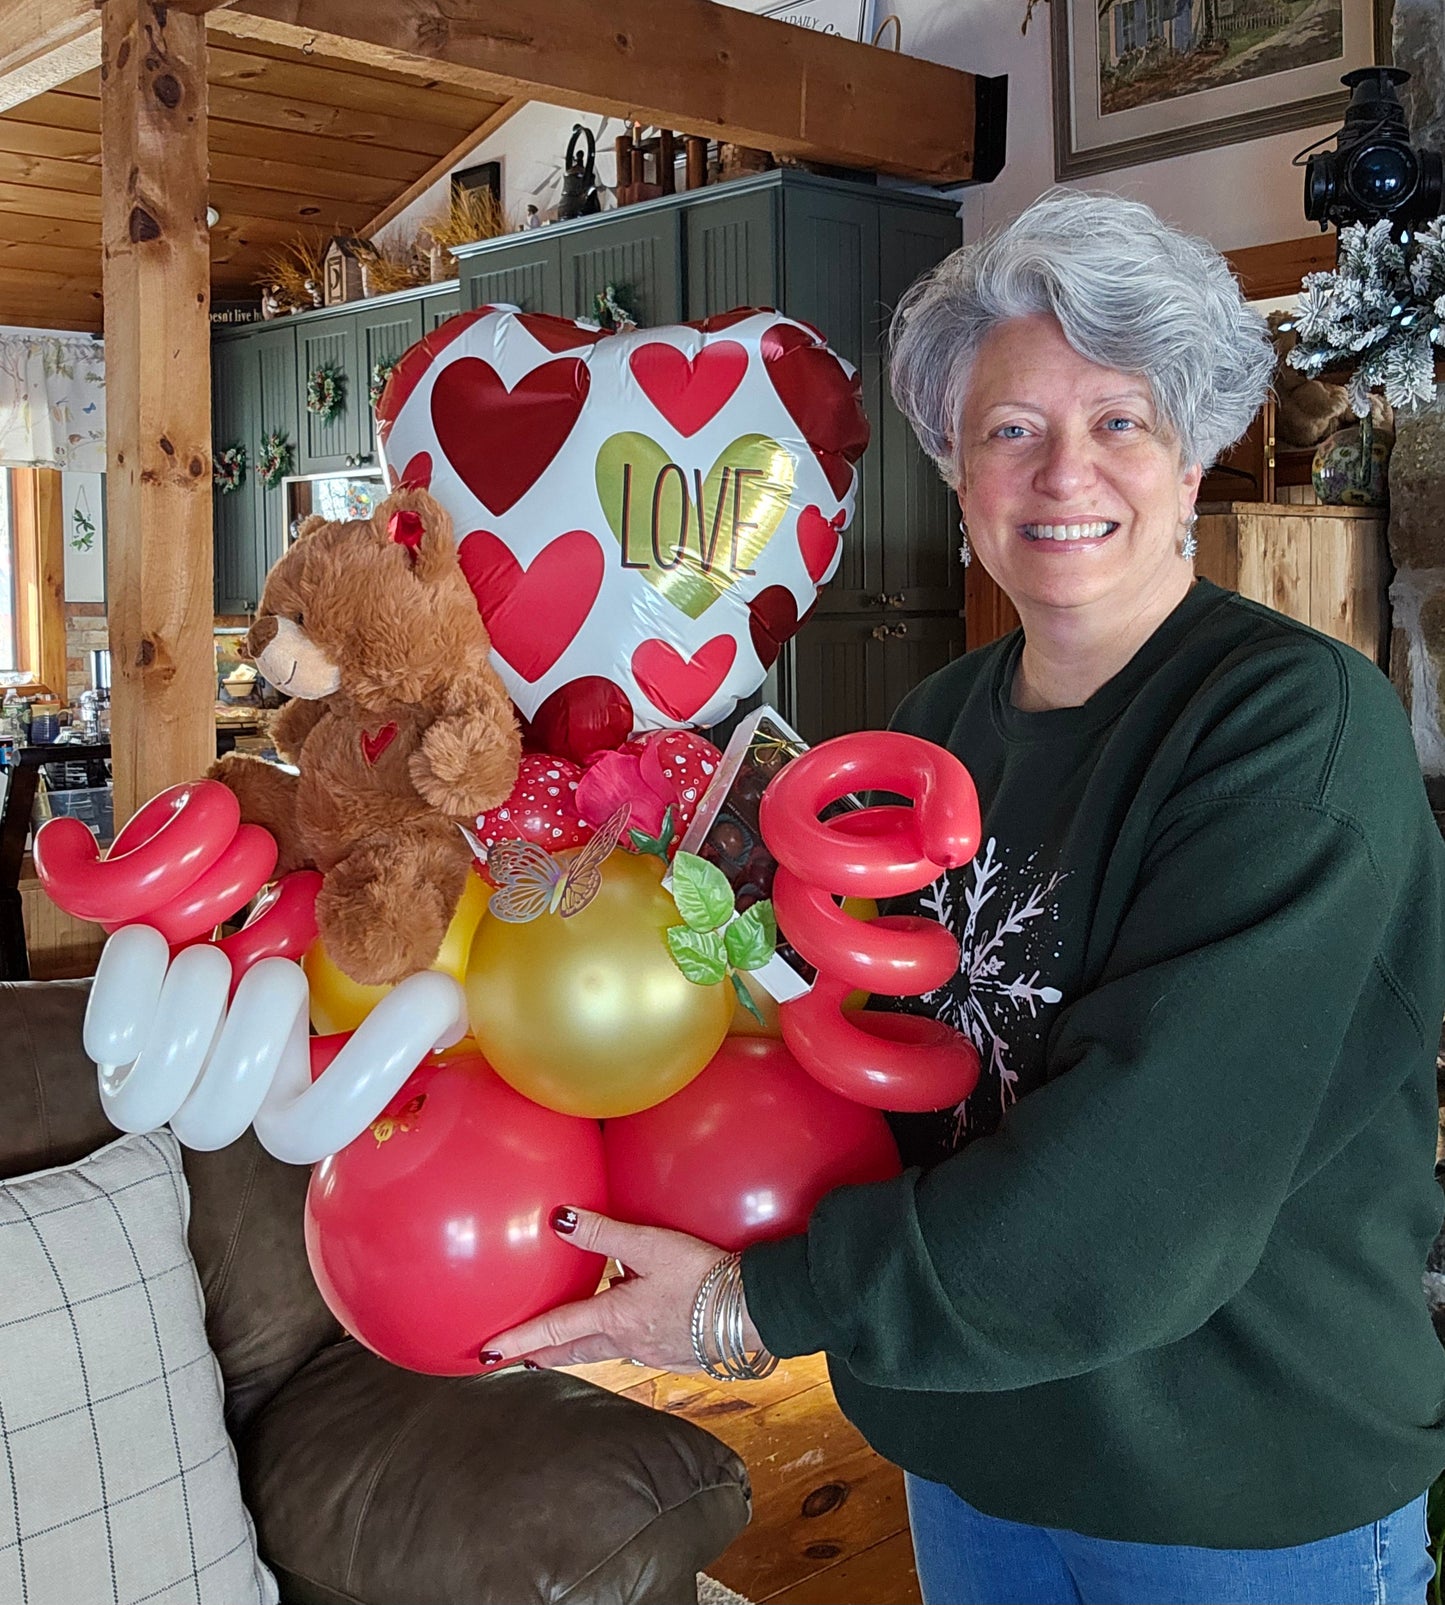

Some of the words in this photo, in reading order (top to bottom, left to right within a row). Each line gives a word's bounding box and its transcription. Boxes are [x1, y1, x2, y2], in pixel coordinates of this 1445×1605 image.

[790, 15, 819, 29] DAILY
[234, 308, 252, 321] live
[620, 463, 764, 576] LOVE
